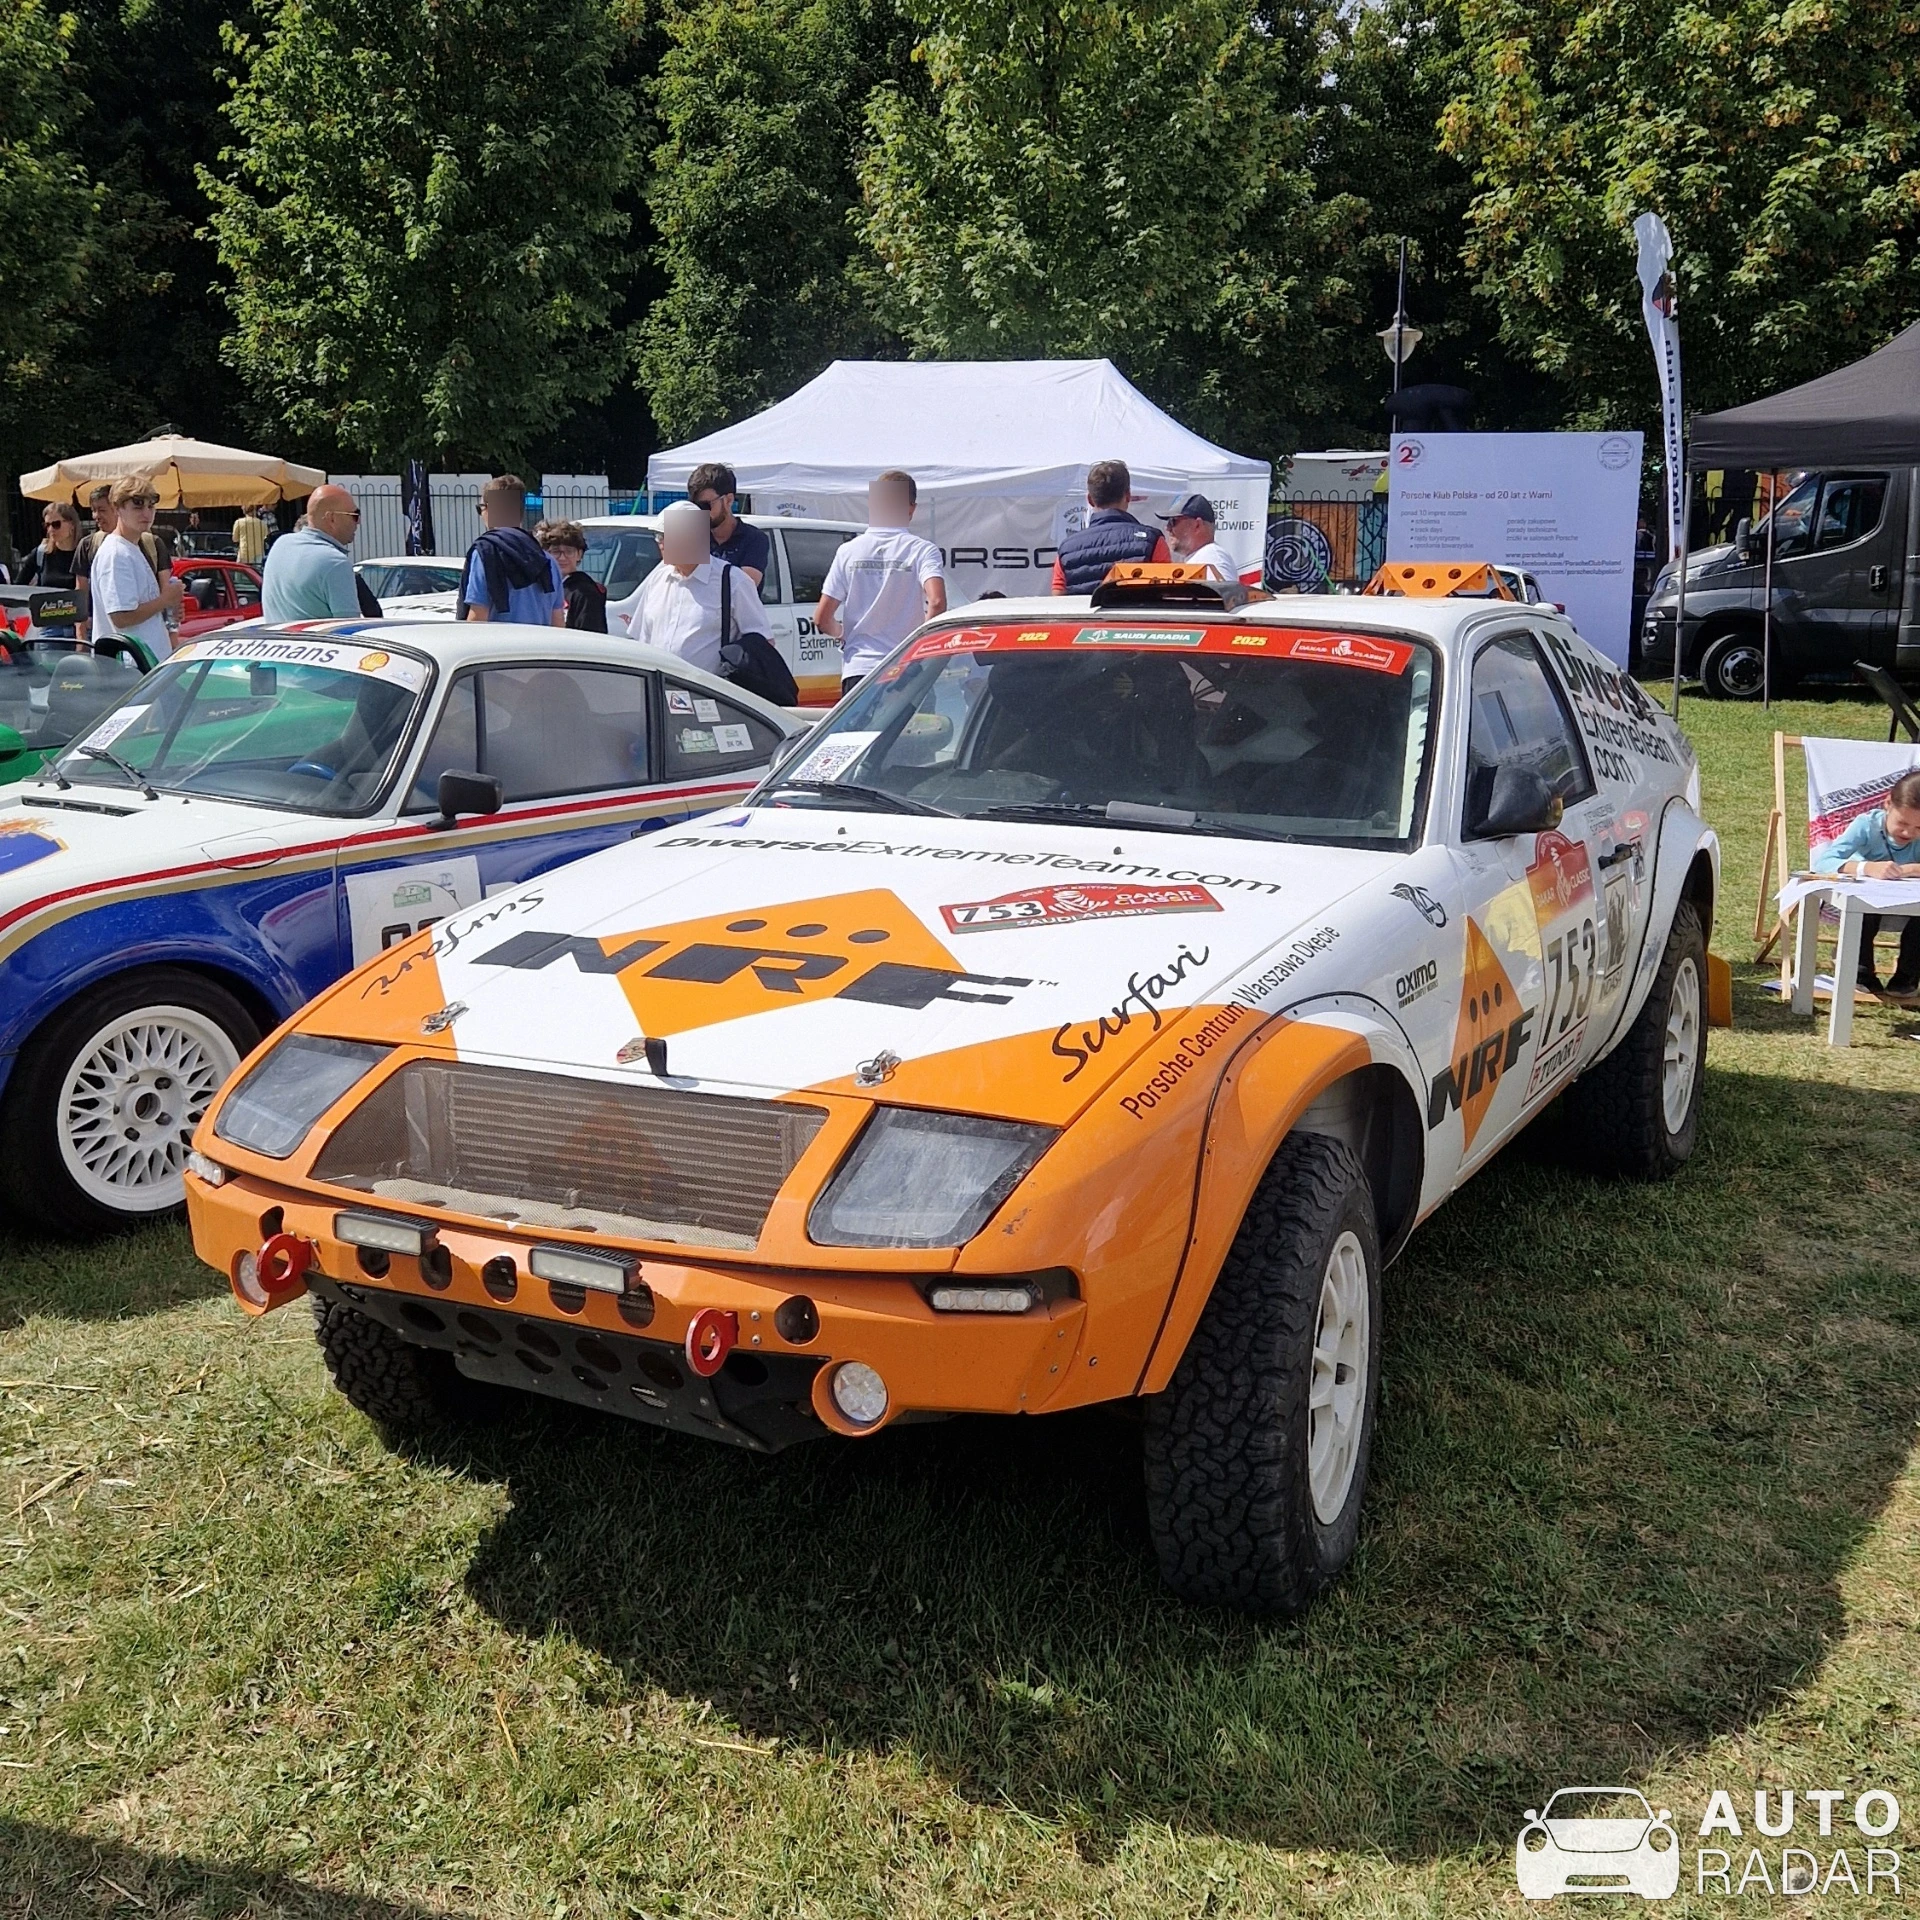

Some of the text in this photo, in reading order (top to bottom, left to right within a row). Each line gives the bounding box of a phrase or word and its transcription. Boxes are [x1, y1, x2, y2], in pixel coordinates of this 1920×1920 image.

[1401, 490, 1431, 500] Porsche
[1433, 490, 1451, 500] Klub
[1453, 490, 1478, 500] Polska
[1485, 490, 1496, 500] od
[1497, 490, 1509, 500] 20
[1511, 490, 1521, 500] lat
[1529, 490, 1553, 500] Wami
[1214, 520, 1255, 531] LDWIDE
[1017, 632, 1050, 642] 2025
[1112, 632, 1147, 640] SAUDI
[1231, 635, 1268, 646] 2025
[205, 638, 340, 663] Rothmans
[799, 650, 824, 661] .com
[1298, 645, 1387, 662] DAKAR CLASSIC
[1594, 745, 1638, 785] .com
[1570, 867, 1591, 889] CLASSIC
[957, 901, 1044, 925] 753
[1016, 907, 1159, 927] SAUDI ARABIA
[1541, 917, 1597, 1048] 753
[1051, 943, 1210, 1083] Surfari
[1118, 925, 1342, 1120] Porsche Centrum Warszawa Okęcie
[1427, 1005, 1535, 1132] NRF
